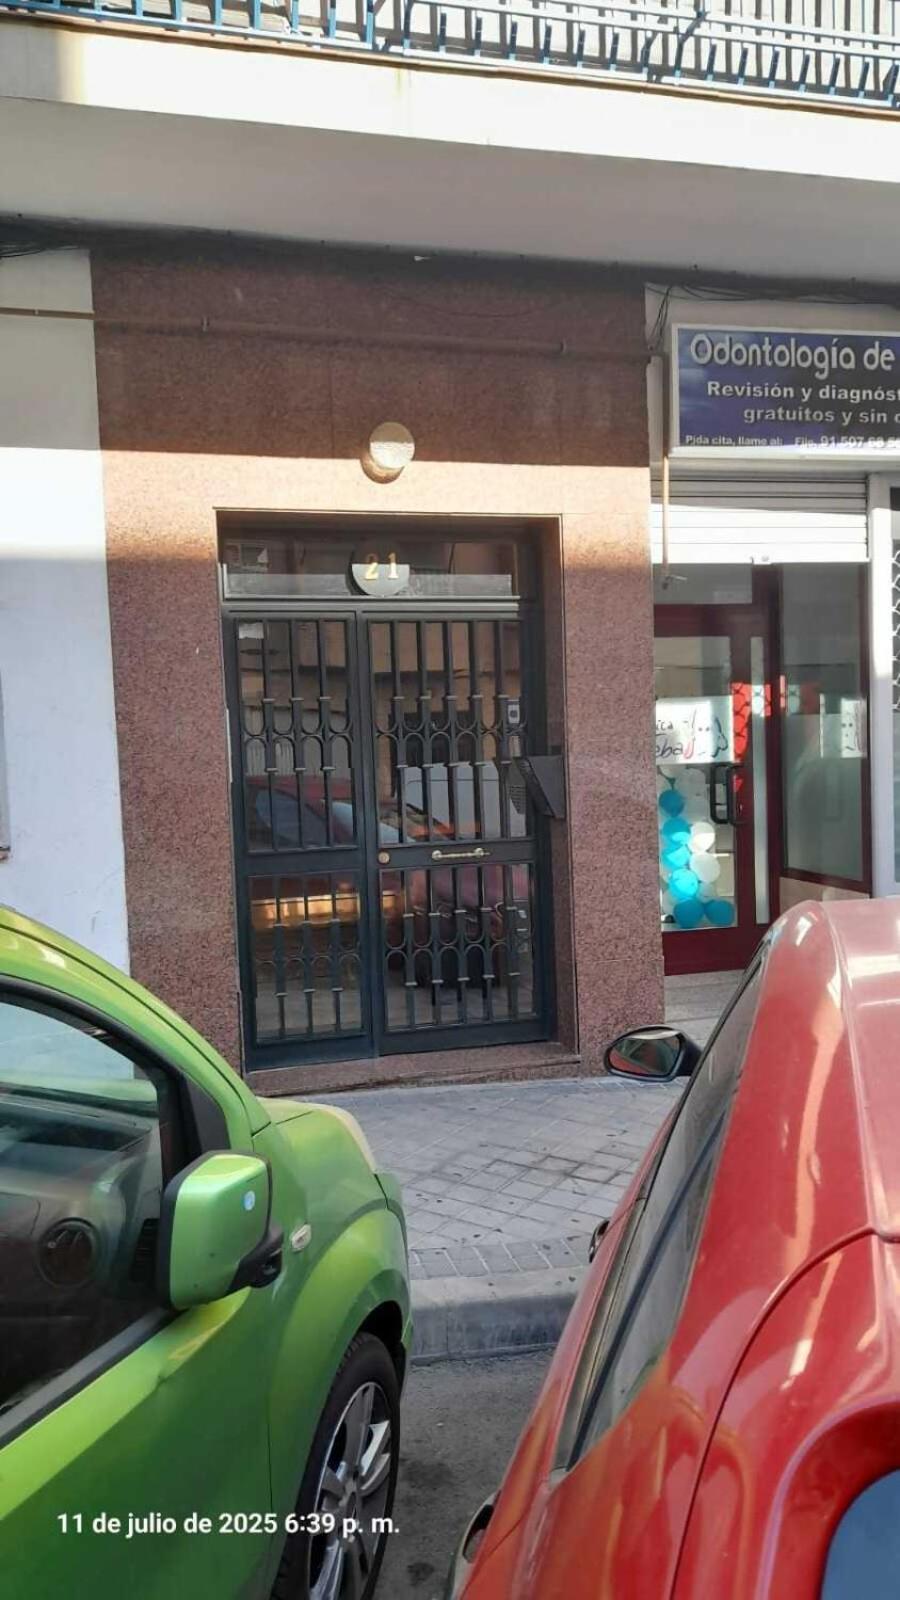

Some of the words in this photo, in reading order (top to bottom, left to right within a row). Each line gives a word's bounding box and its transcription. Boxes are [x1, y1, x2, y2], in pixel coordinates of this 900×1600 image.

[691, 333, 855, 380] Odontología
[863, 340, 896, 371] de
[707, 381, 794, 398] Revisión
[801, 387, 812, 402] y
[743, 407, 835, 424] gratuitos
[842, 411, 853, 426] y
[859, 409, 888, 423] sin
[738, 436, 768, 446] llame
[820, 435, 836, 448] 91
[365, 552, 399, 580] 21
